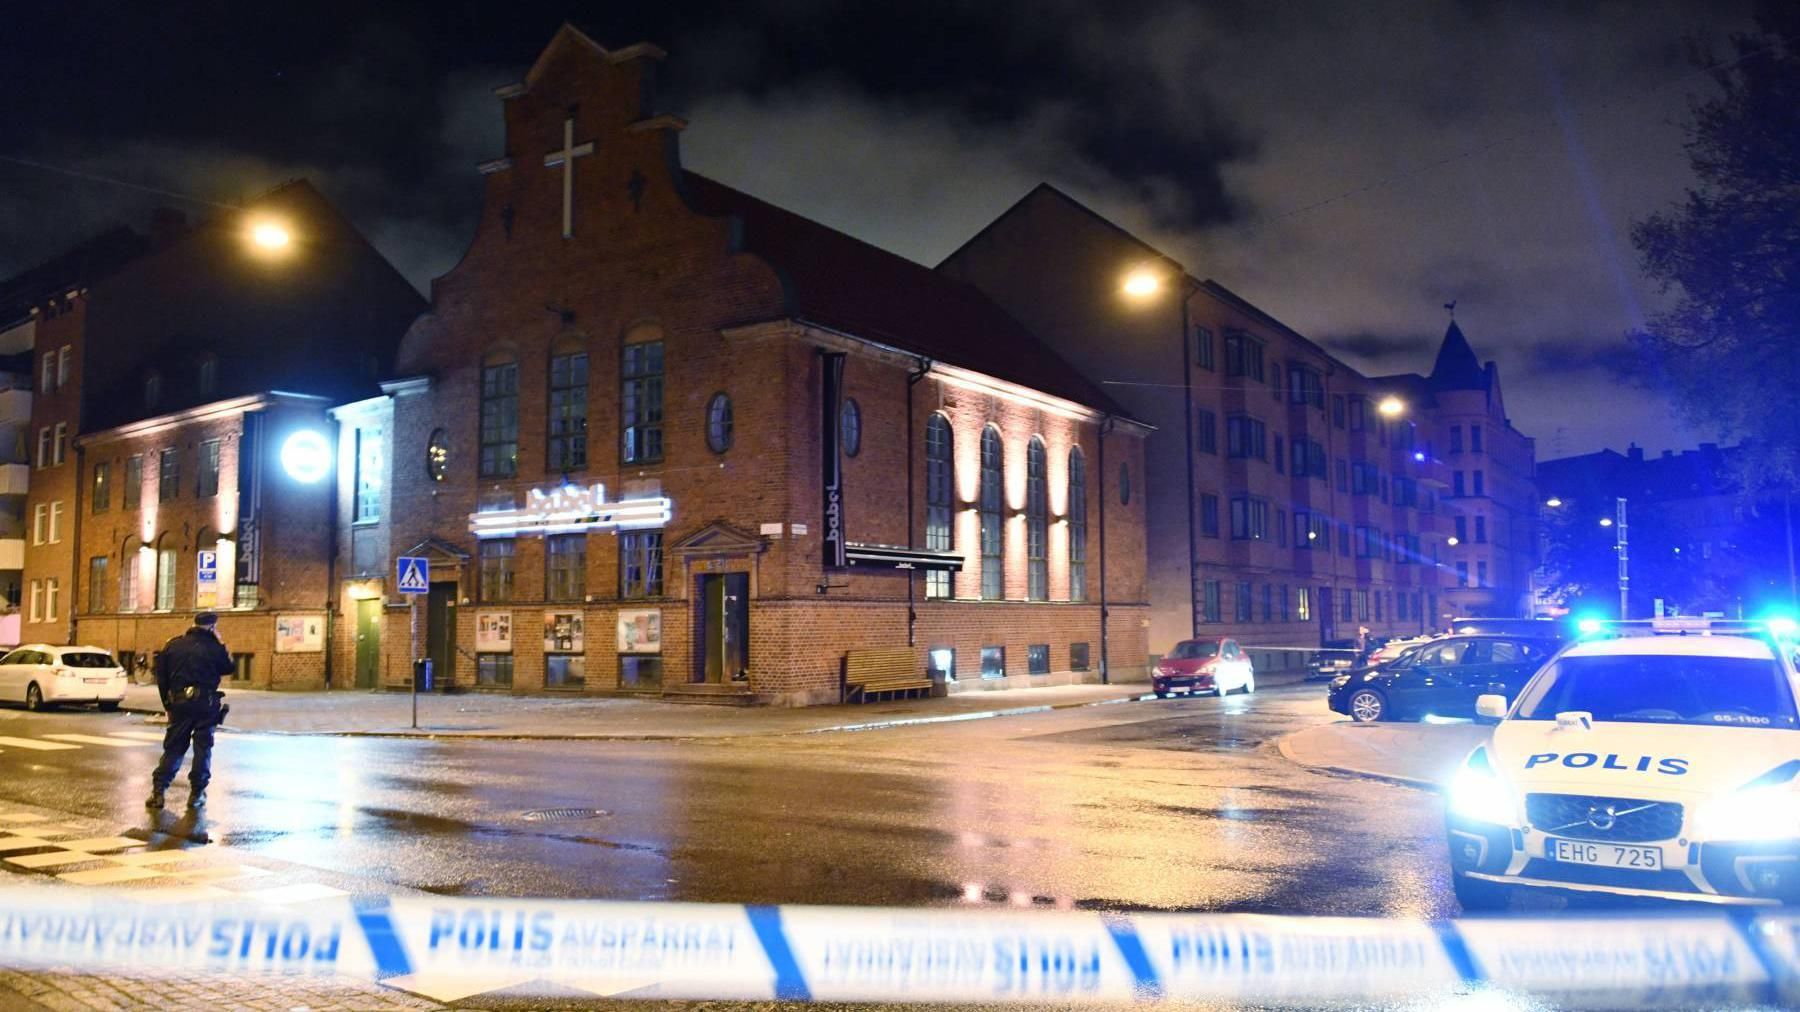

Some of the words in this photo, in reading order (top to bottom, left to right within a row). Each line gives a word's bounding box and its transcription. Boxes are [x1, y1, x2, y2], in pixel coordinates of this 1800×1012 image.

[827, 486, 840, 541] babel
[203, 553, 215, 569] P
[1713, 714, 1770, 725] 65-1100
[1524, 752, 1690, 776] POLIS
[1558, 842, 1598, 862] EHG
[1613, 847, 1656, 867] 725
[207, 917, 341, 960] POLIS
[429, 909, 556, 950] POLIS
